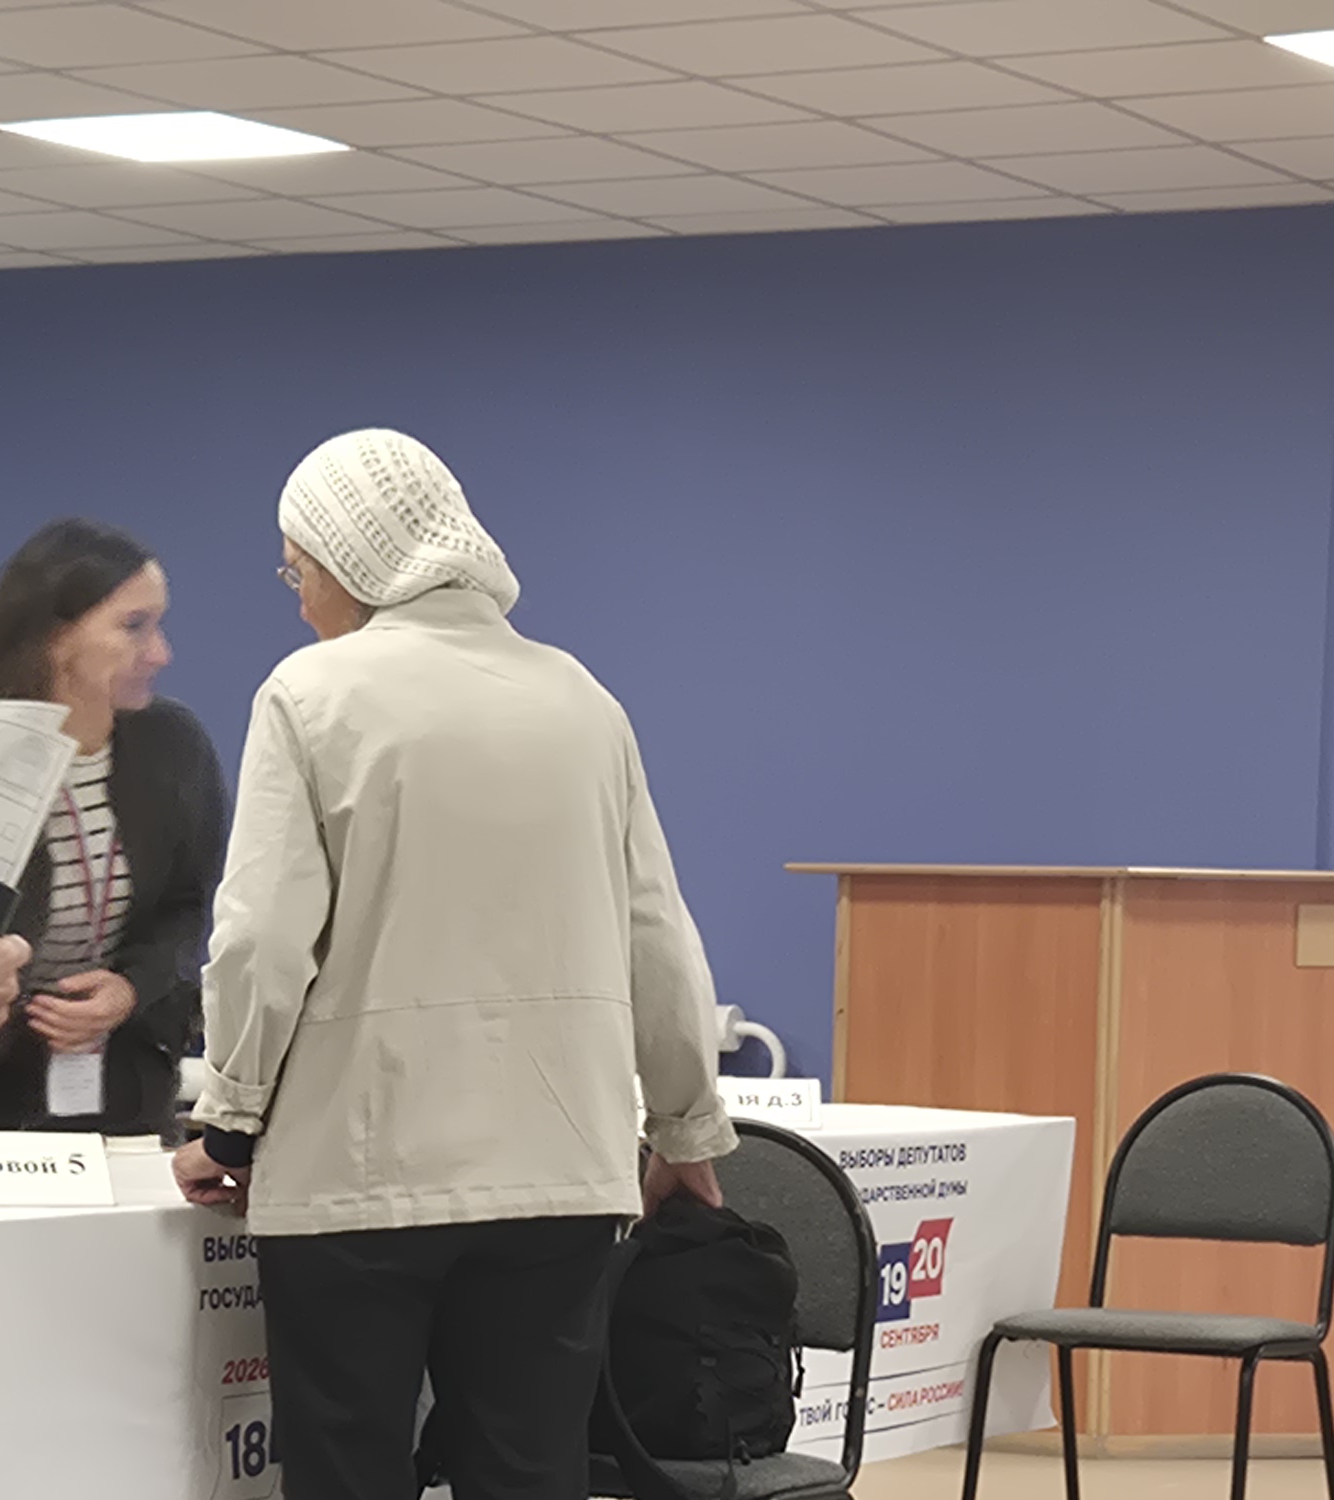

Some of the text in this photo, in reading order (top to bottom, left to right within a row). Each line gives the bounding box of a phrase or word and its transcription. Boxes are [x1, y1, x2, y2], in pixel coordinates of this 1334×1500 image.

[68, 1153, 87, 1175] 5
[839, 1143, 966, 1170] ВЫБОРЫ ДЕПУТАТОВ
[859, 1178, 936, 1204] ДАРСТВЕННОЙ
[204, 1234, 258, 1262] ВЫБО
[880, 1237, 943, 1306] 19 20
[200, 1285, 263, 1311] ГОСУД
[880, 1323, 940, 1349] СЕНТЯБРЯ
[799, 1399, 832, 1427] ТВОЙ
[225, 1420, 267, 1480] 18
